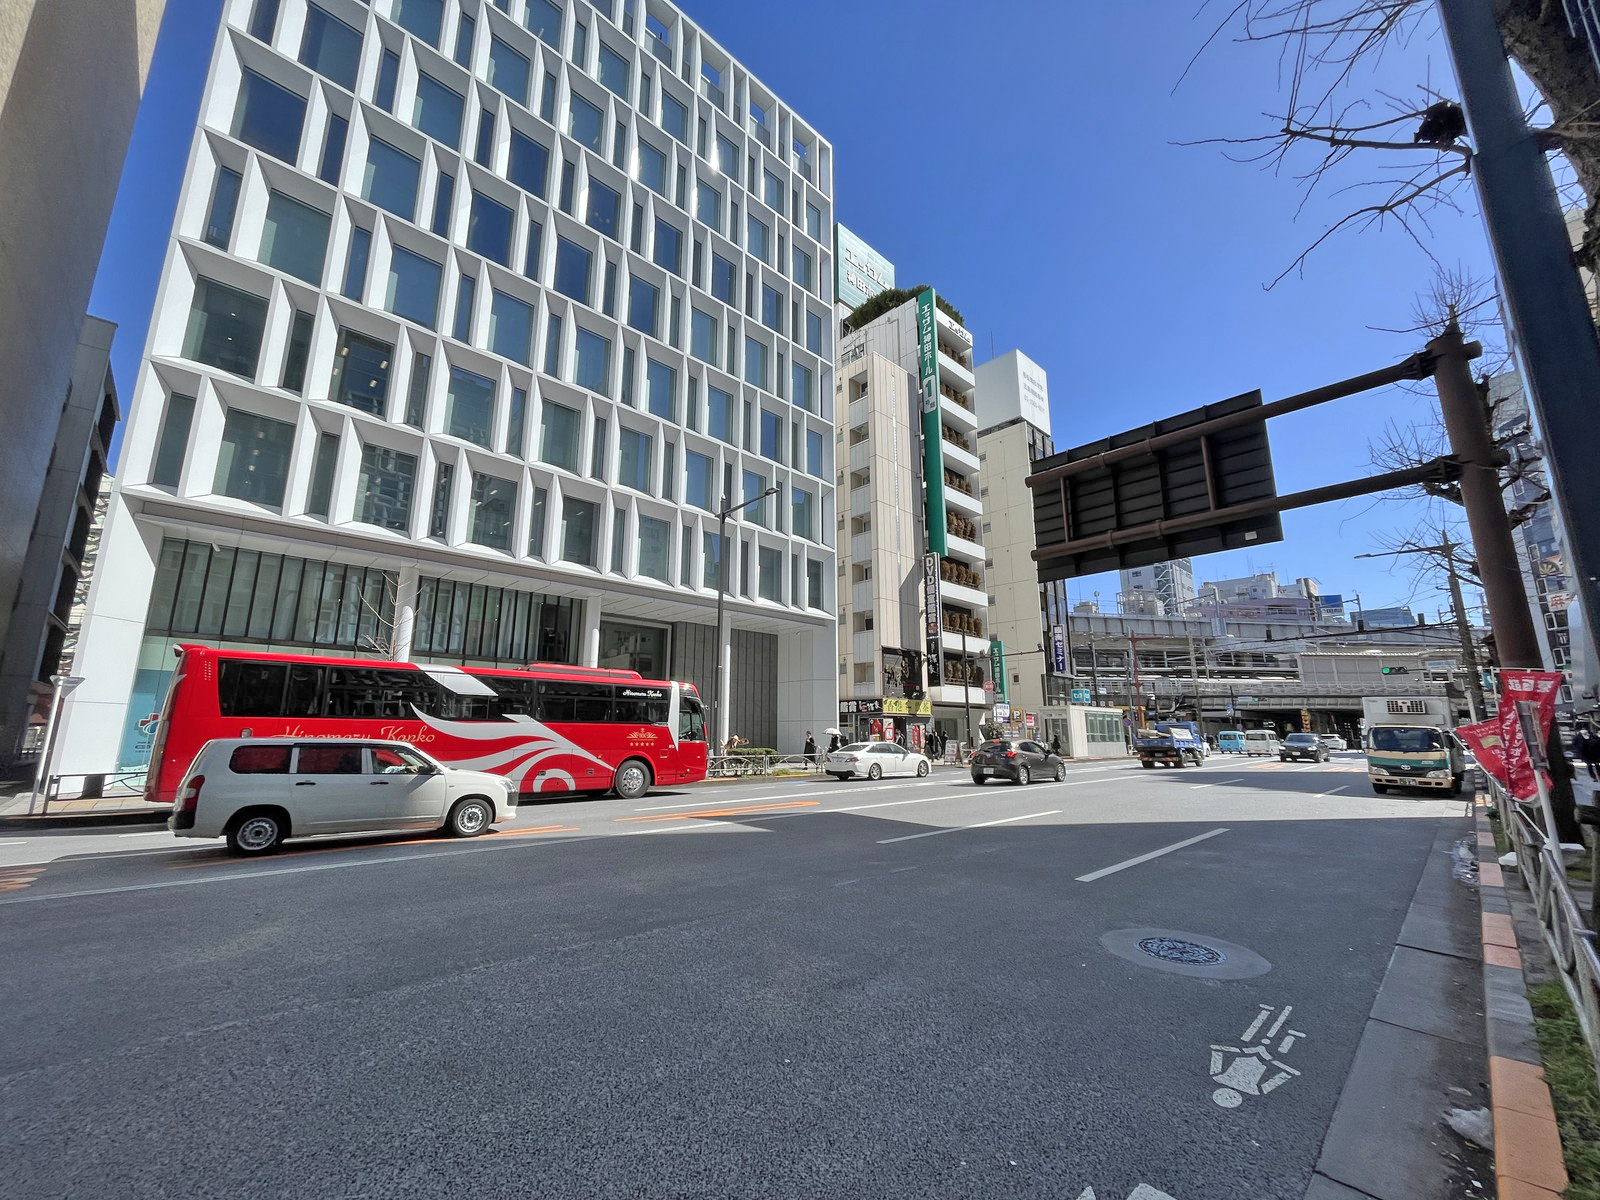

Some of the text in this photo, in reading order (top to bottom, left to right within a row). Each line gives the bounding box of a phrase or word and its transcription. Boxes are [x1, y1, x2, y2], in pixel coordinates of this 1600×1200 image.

[921, 303, 933, 376] エッサム神田ホール
[1013, 710, 1021, 720] P
[380, 726, 435, 743] Kanko
